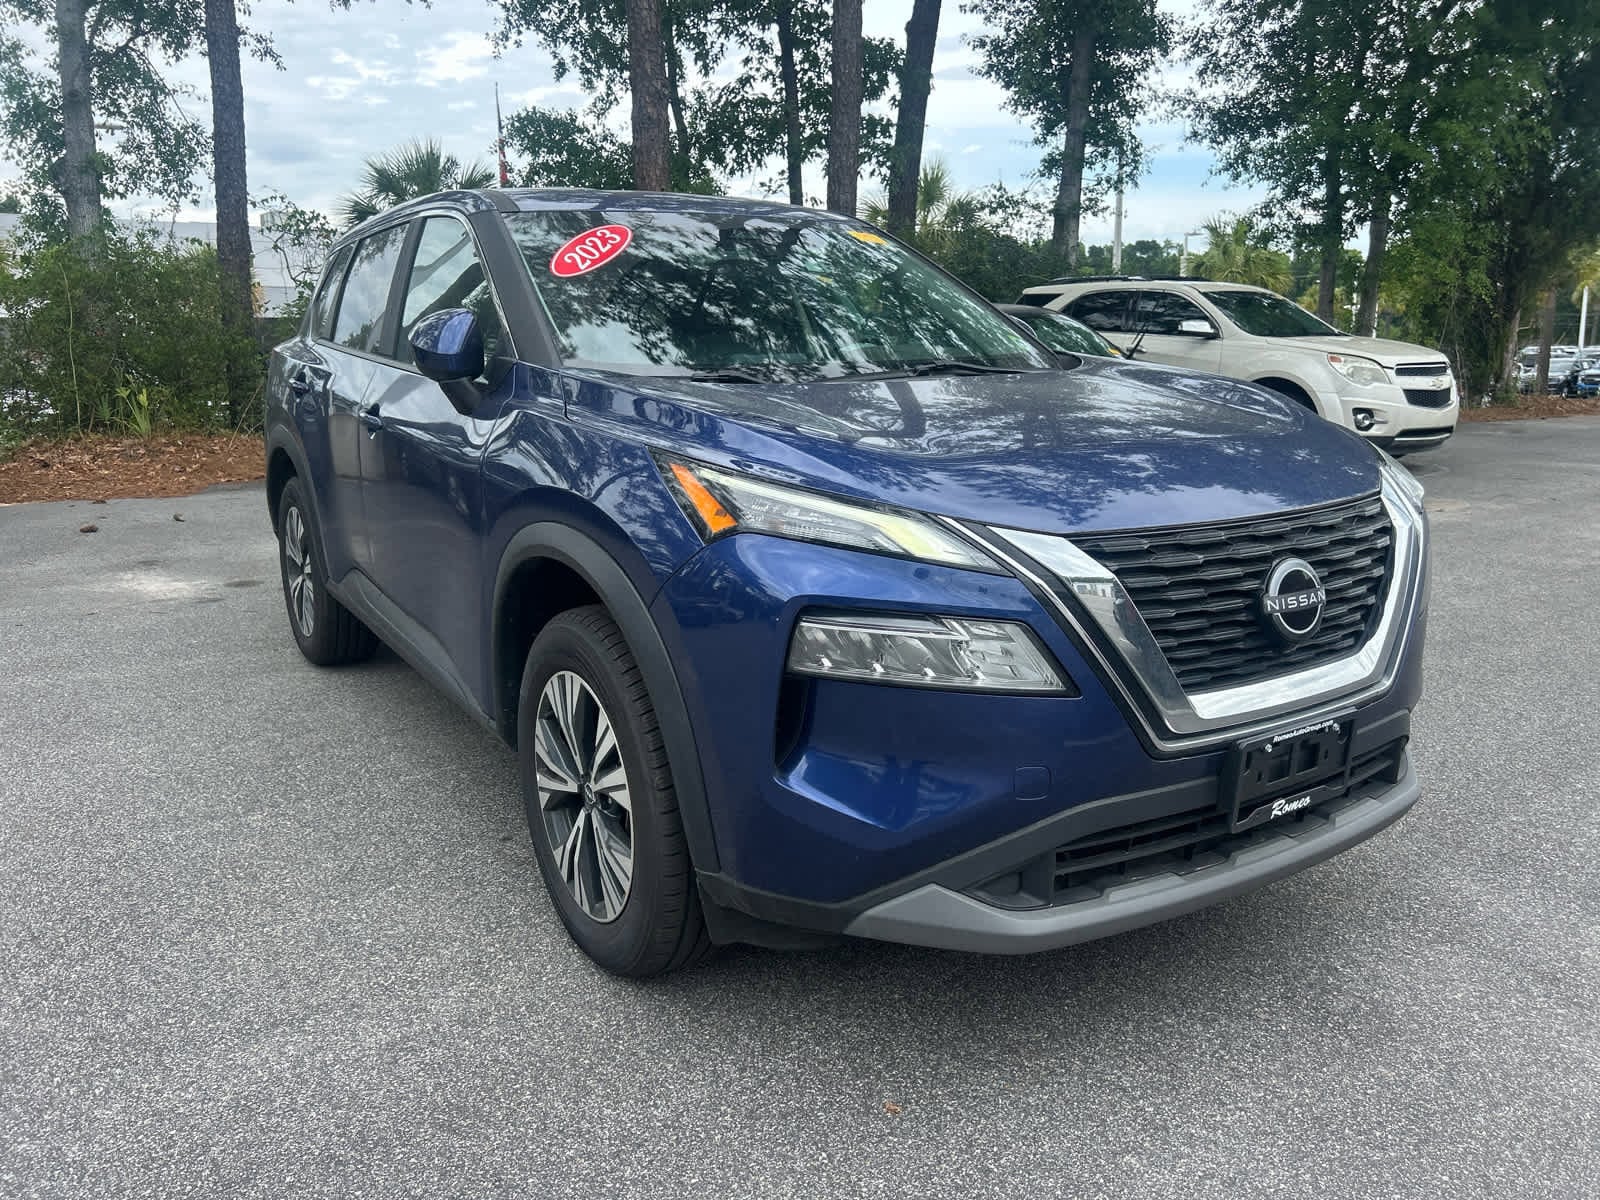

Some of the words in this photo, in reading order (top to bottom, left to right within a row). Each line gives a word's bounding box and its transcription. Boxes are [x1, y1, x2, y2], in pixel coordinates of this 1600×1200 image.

[564, 229, 621, 271] 2023
[1266, 591, 1326, 611] NISSAN
[1270, 796, 1311, 820] Romeo
